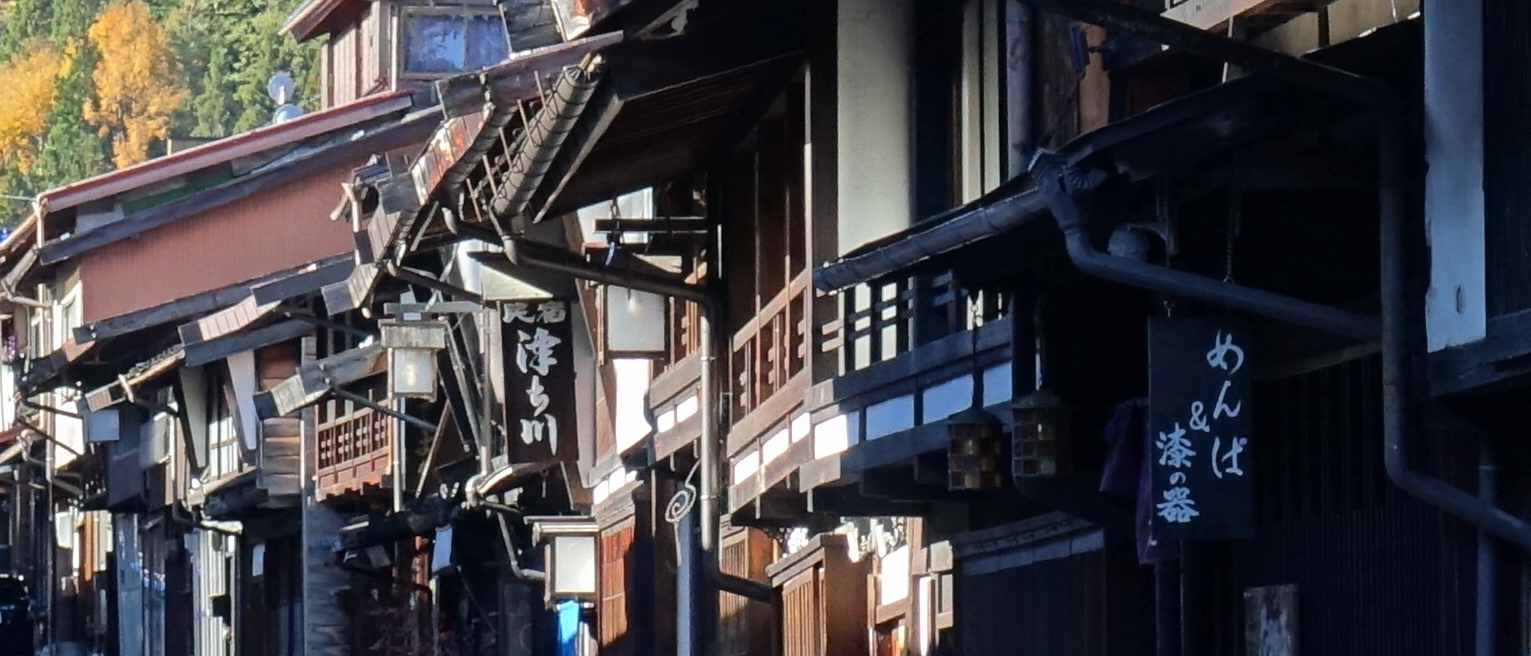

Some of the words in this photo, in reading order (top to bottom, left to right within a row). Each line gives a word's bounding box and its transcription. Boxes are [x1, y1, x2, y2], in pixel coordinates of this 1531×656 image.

[1189, 401, 1210, 432] &
[1207, 330, 1247, 479] めんぱ
[1155, 422, 1200, 524] 漆の器
